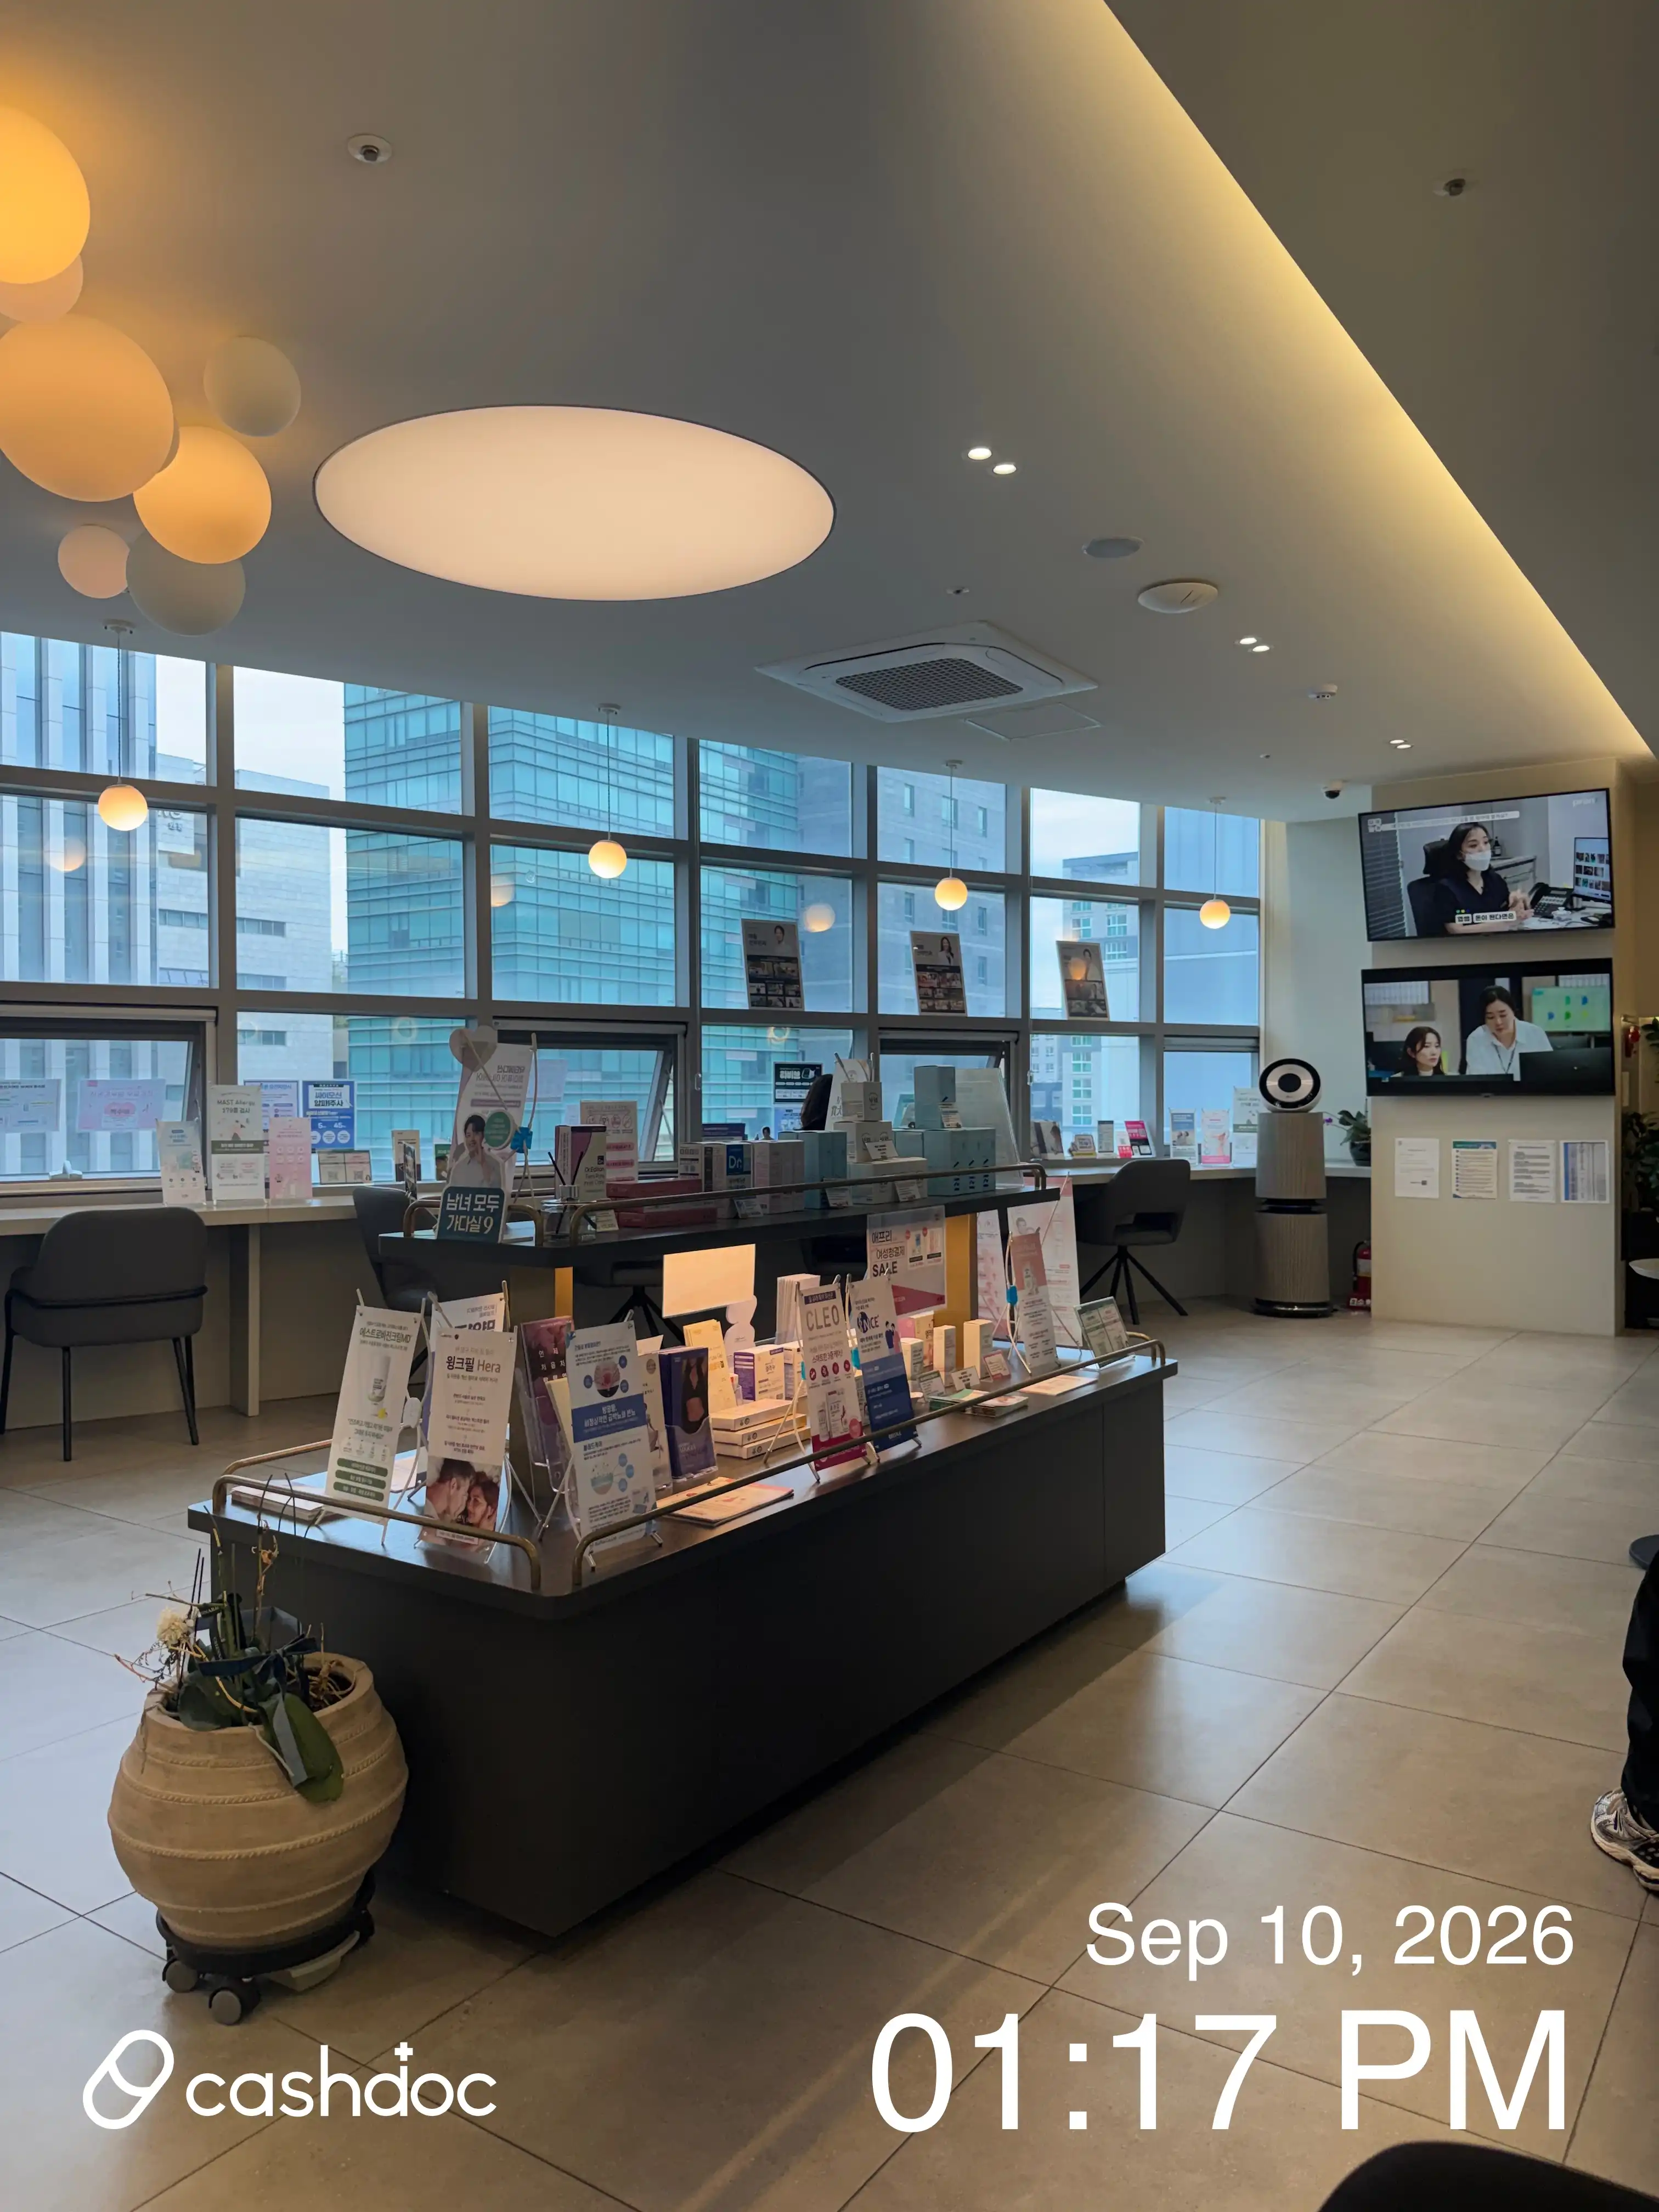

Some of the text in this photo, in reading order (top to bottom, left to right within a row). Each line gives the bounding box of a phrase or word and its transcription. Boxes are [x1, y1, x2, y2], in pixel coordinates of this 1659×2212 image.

[447, 1193, 500, 1212] 남녀 모두
[872, 1230, 893, 1244] 애프리
[876, 1246, 905, 1260] 여성청결제
[872, 1261, 898, 1278] SALE
[806, 1305, 839, 1331] CLEO
[446, 1356, 501, 1373] 윙크필 Hera
